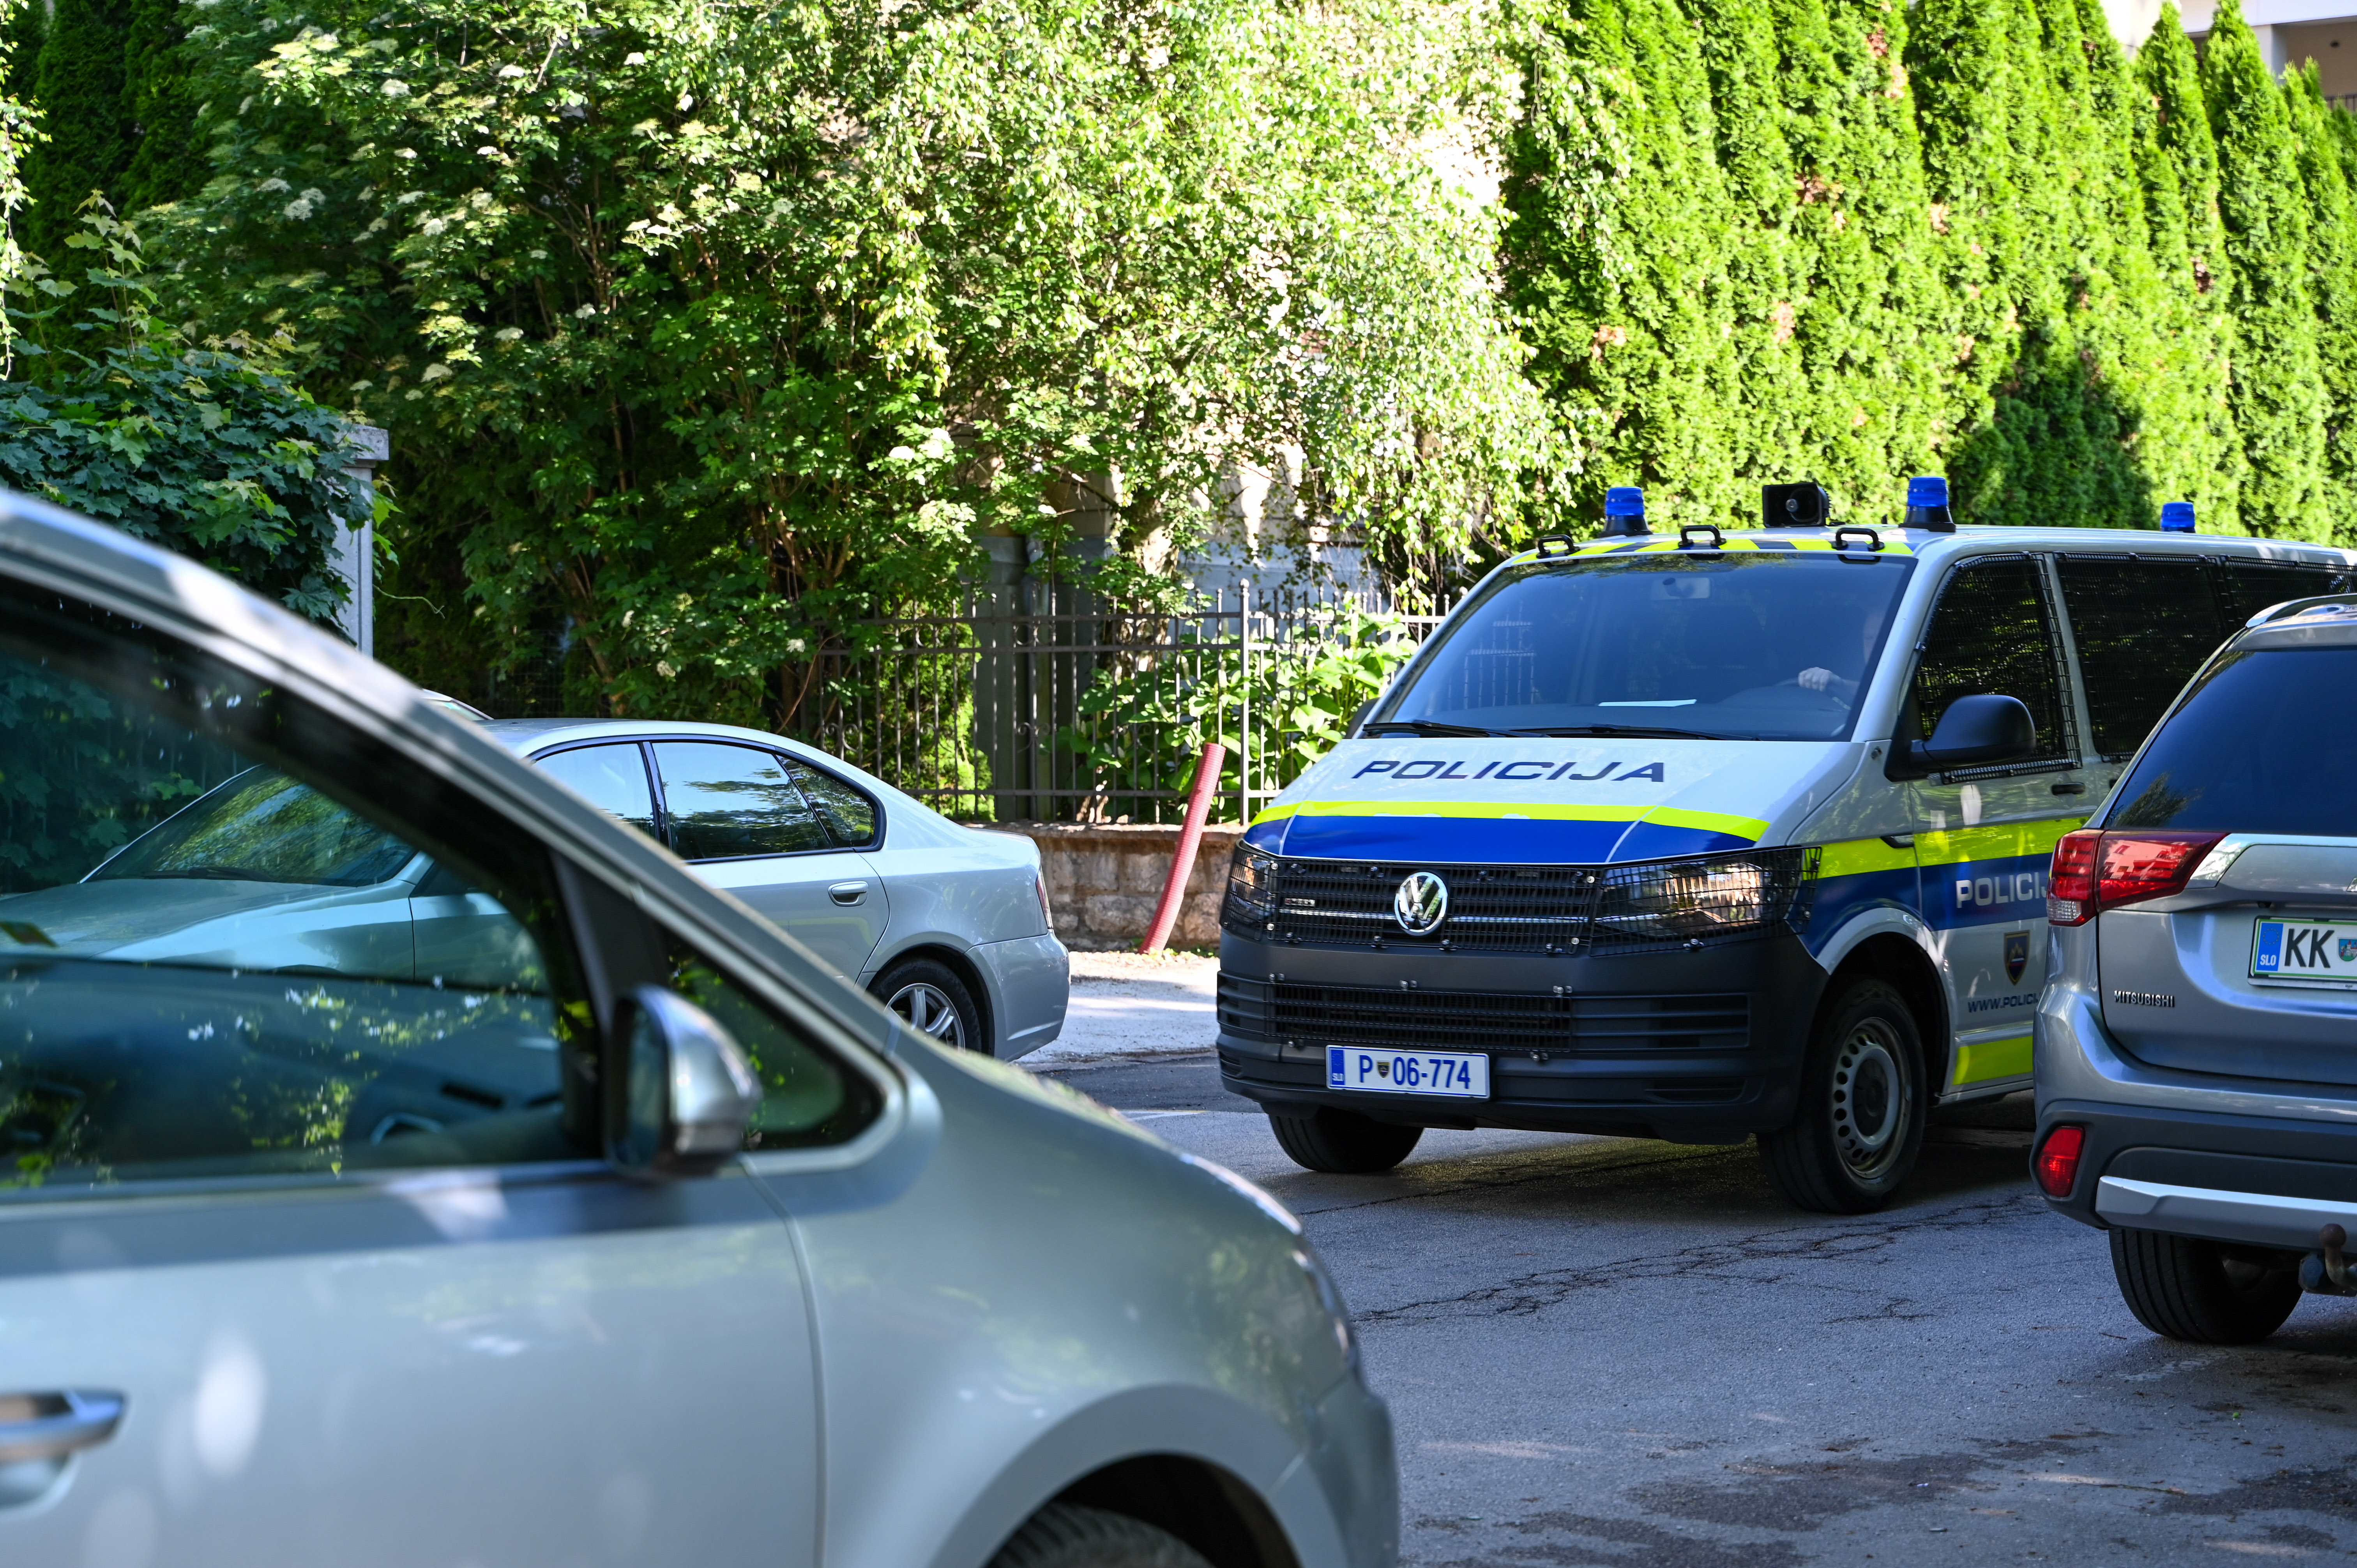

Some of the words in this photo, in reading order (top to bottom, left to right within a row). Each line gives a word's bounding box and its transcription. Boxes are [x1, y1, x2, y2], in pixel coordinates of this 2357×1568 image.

[1351, 761, 1665, 782] POLICIJA
[2285, 928, 2335, 968] KK
[2260, 954, 2276, 966] SLO
[2114, 990, 2175, 1007] MITSUBISHI
[1393, 1056, 1471, 1089] 06-774
